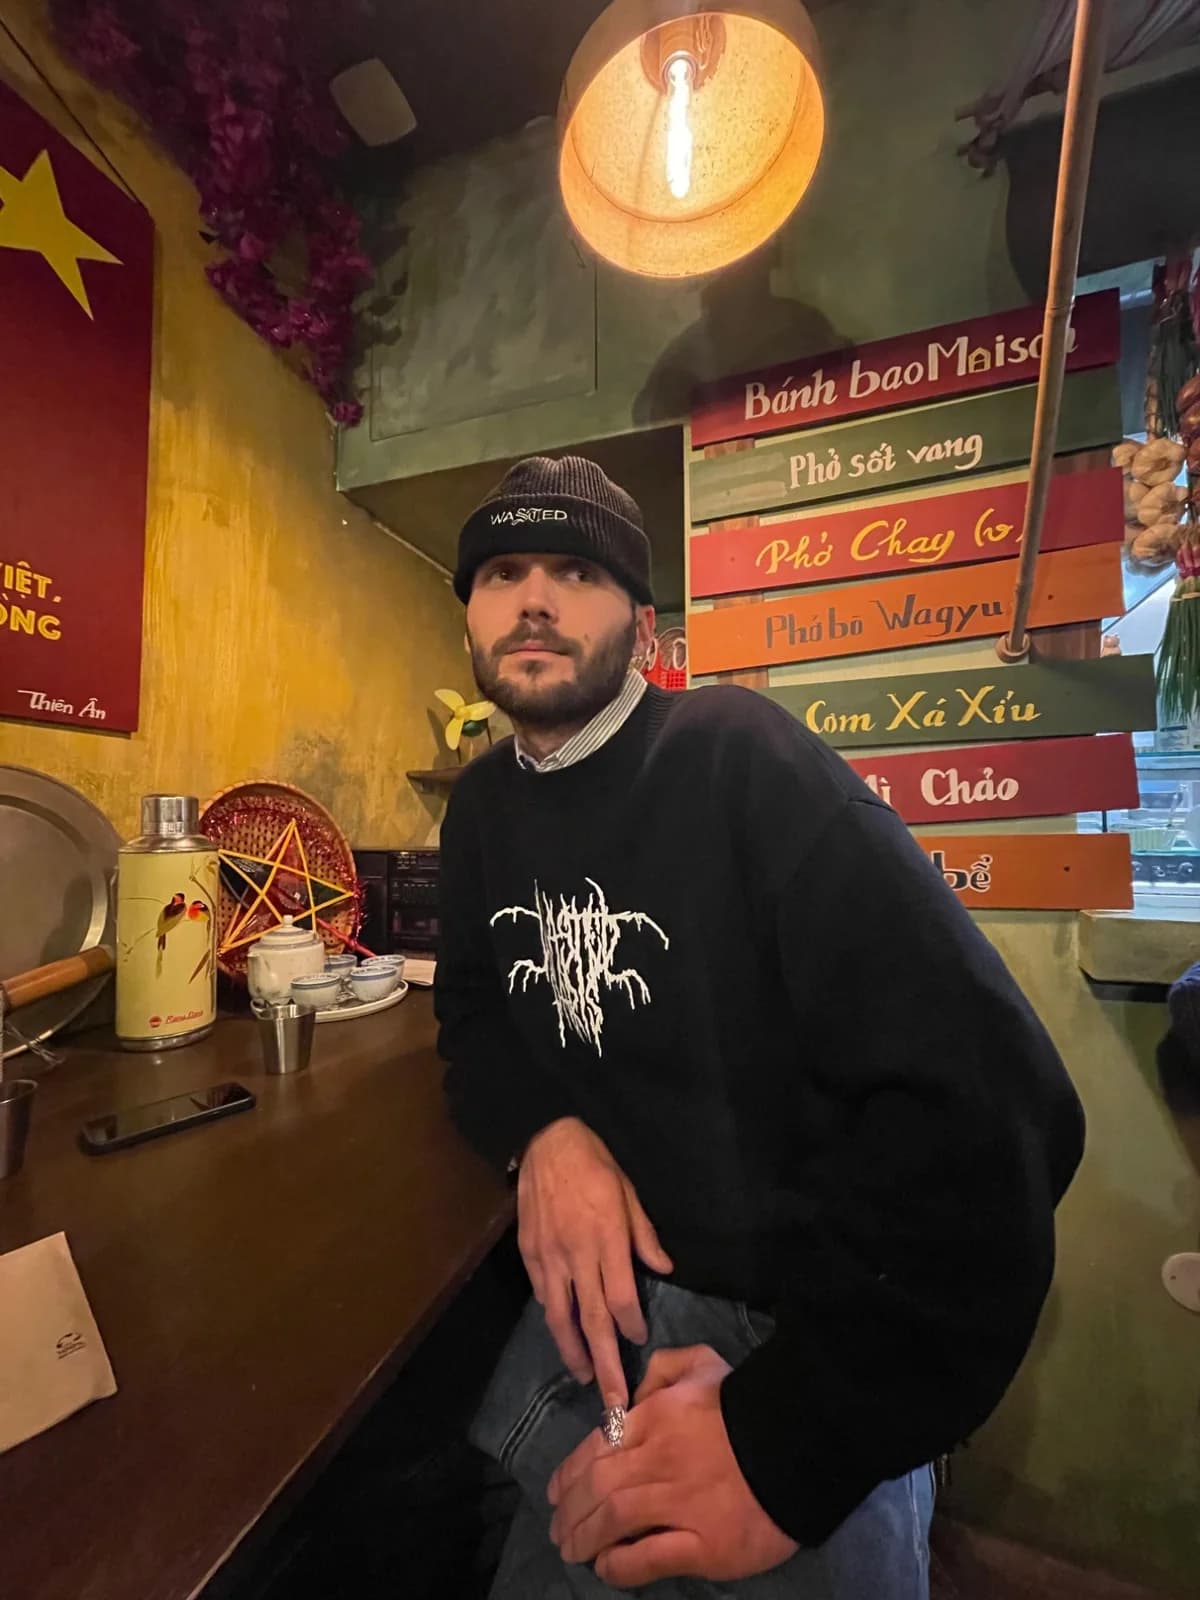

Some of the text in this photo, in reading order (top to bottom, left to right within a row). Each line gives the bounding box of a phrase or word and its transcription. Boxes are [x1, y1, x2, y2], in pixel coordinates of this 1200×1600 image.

[744, 367, 838, 420] Bánh
[848, 359, 924, 398] bao
[906, 434, 984, 470] vang
[490, 507, 568, 526] WASTED
[850, 517, 955, 563] Chay
[869, 593, 1004, 638] Wagyu
[17, 689, 74, 715] Thiên
[885, 690, 948, 731] Xá
[920, 766, 1020, 807] Chảo
